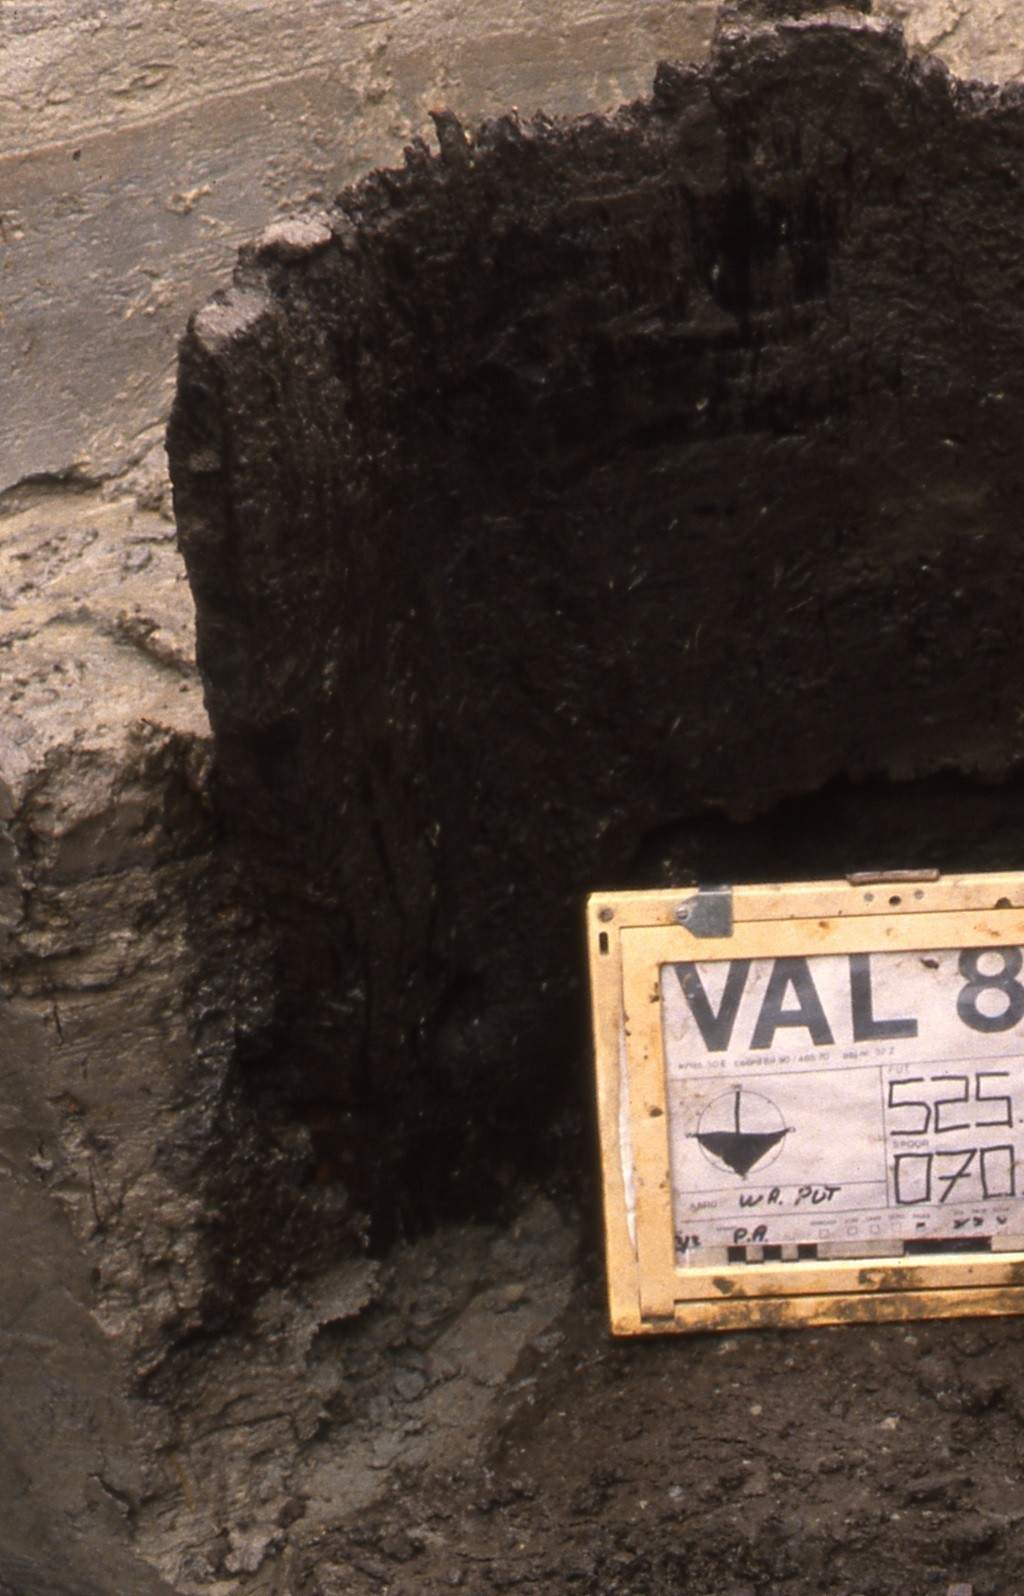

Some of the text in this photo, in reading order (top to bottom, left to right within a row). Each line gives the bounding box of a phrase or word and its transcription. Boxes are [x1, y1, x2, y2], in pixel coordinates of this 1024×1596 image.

[674, 952, 919, 1053] VAL
[893, 1138, 930, 1149] SPOOR
[794, 1184, 842, 1206] PUT
